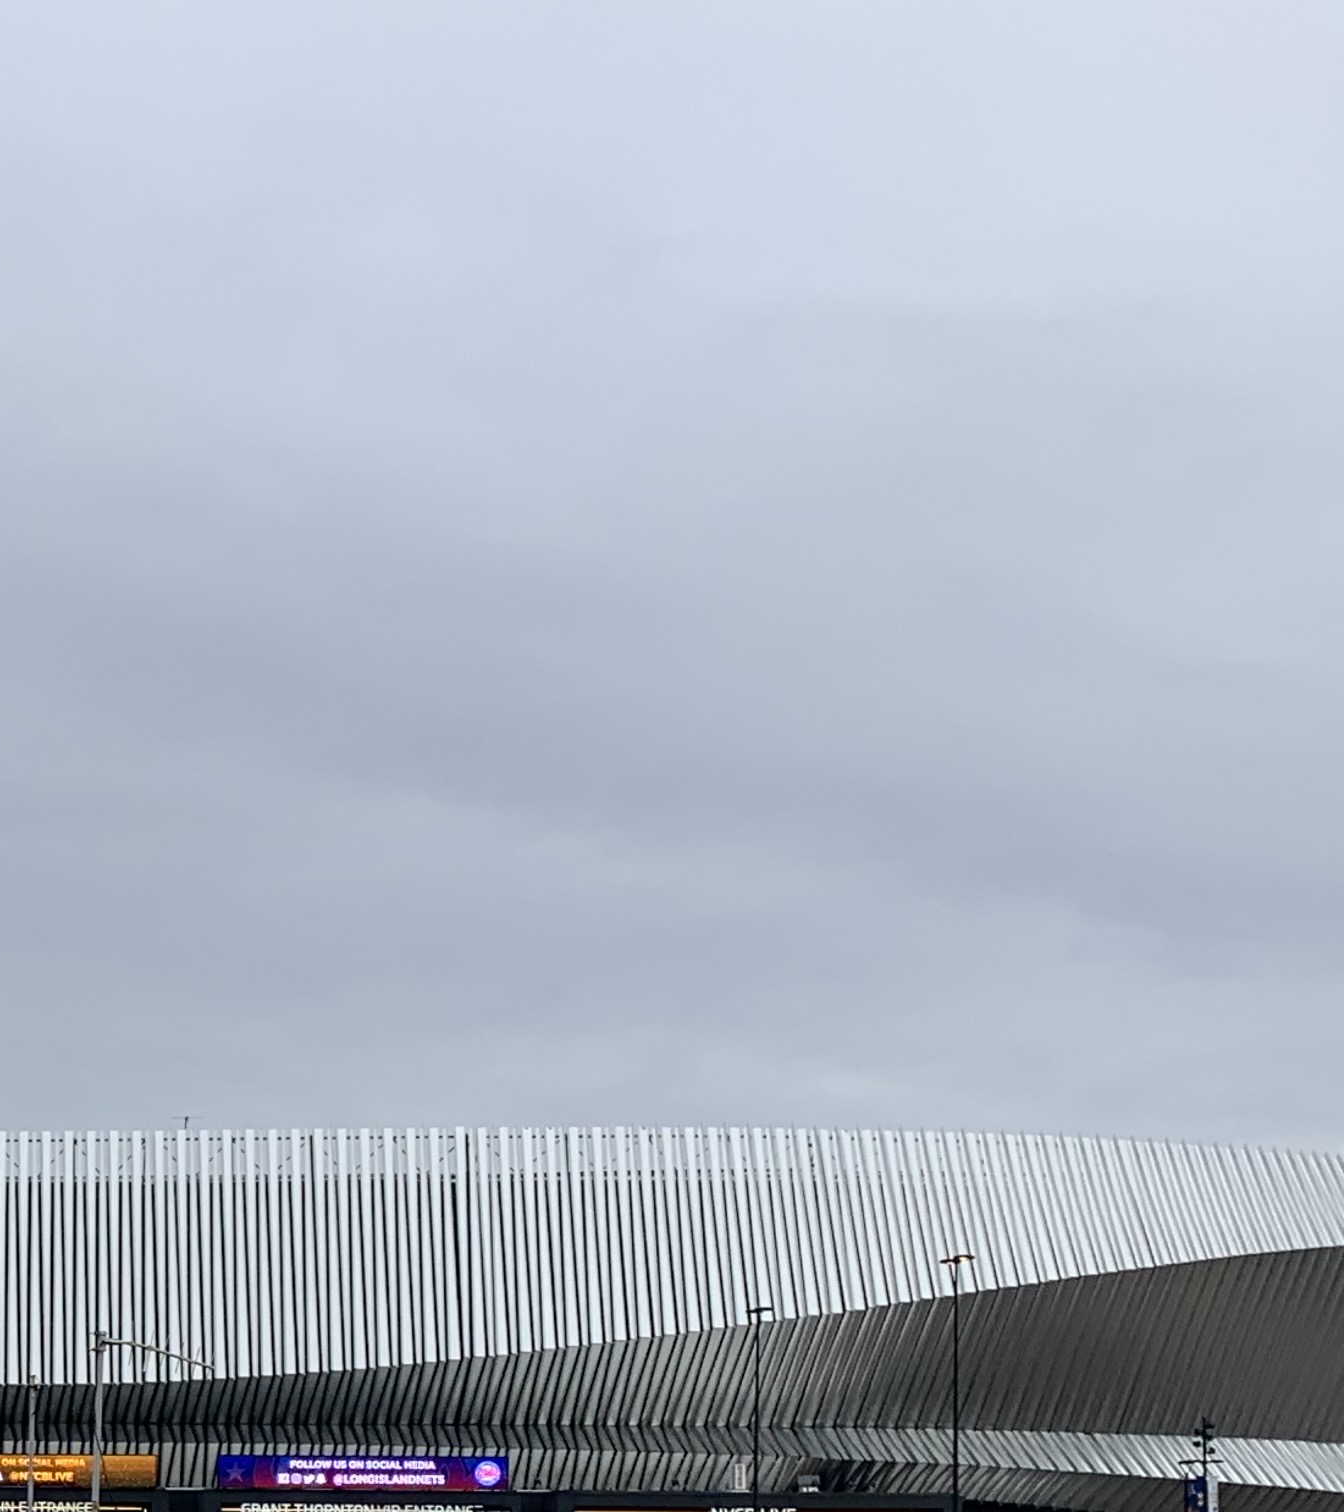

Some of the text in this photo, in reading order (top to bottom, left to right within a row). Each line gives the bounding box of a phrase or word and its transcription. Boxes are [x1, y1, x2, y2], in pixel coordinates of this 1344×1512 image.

[1, 1458, 16, 1467] ON
[55, 1458, 86, 1467] MEDIA
[289, 1460, 437, 1470] FOLLOW US ON SOCIAL MEDIA
[333, 1473, 446, 1485] @LONGISLANDNETS
